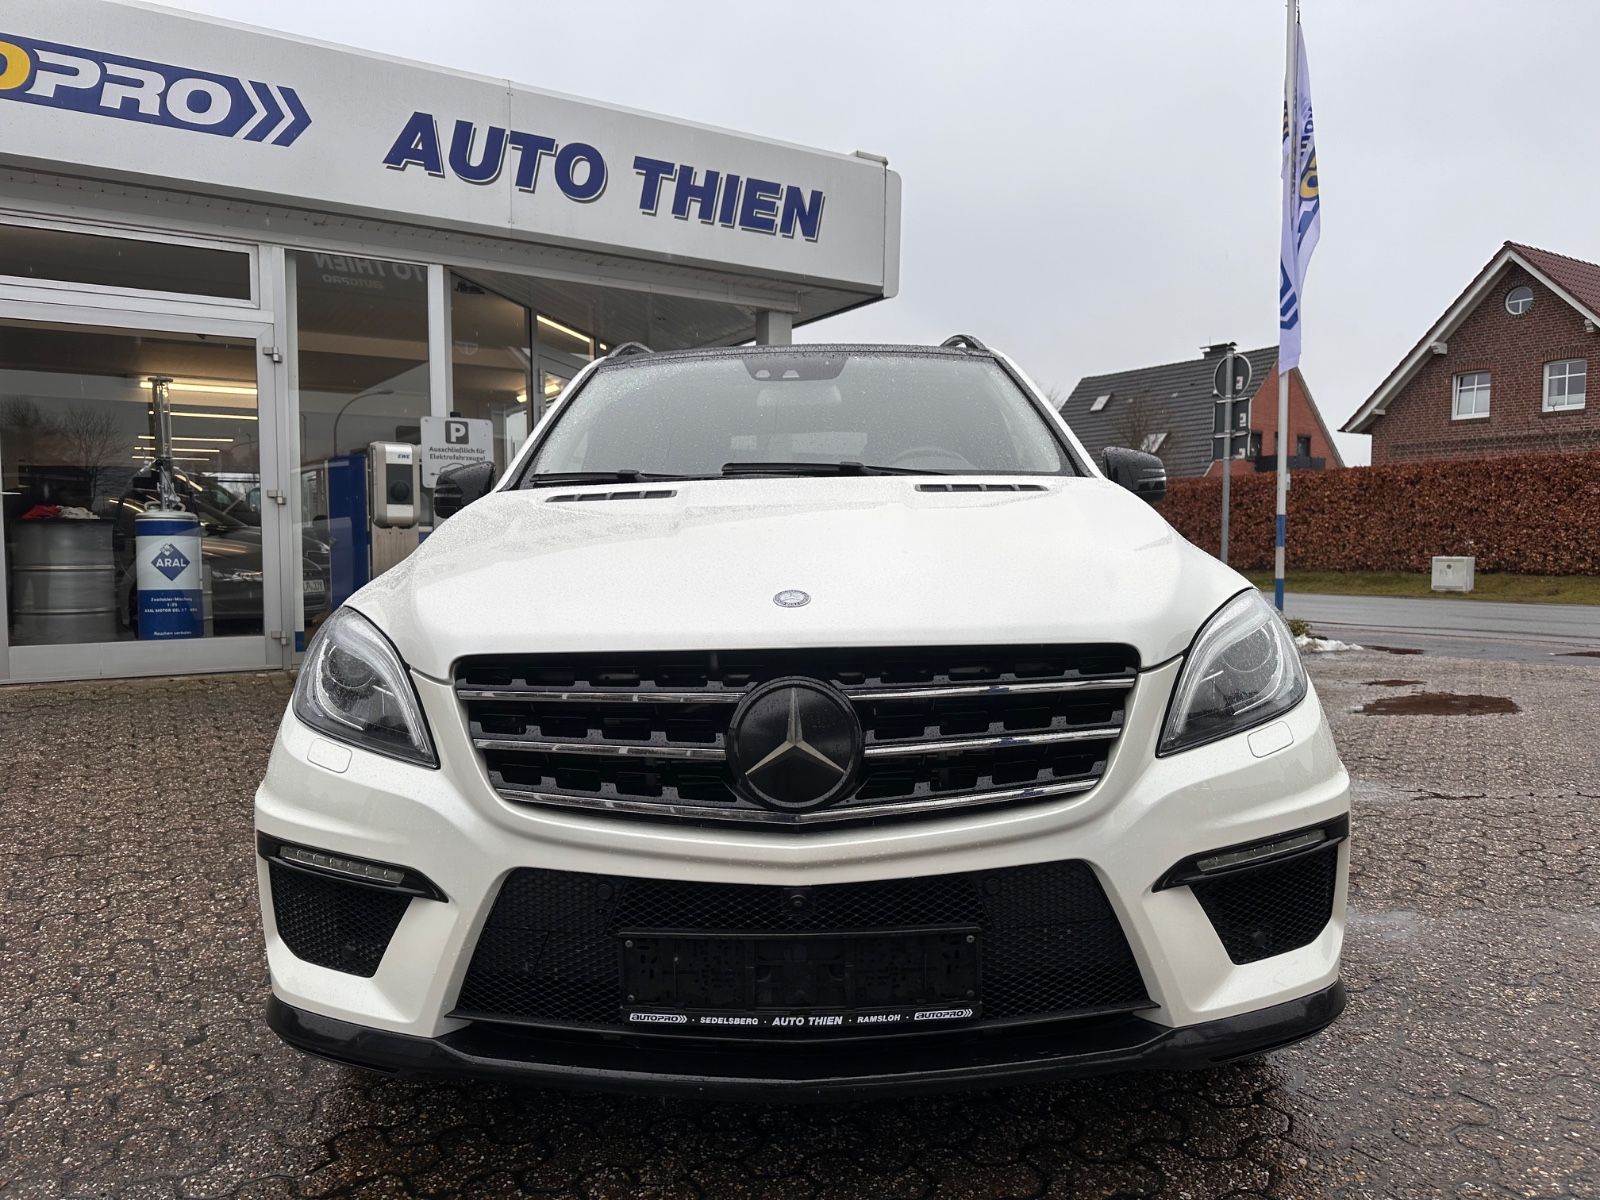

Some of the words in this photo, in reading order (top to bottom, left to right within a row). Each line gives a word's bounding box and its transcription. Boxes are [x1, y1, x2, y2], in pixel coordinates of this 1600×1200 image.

[383, 111, 608, 203] AUTO
[633, 155, 825, 241] THIEN
[450, 422, 466, 442] P
[156, 558, 187, 567] ARAL
[700, 1016, 759, 1025] SEDELSBERG
[772, 1016, 805, 1026] AUTO
[808, 1016, 844, 1026] THIEN
[857, 1014, 901, 1023] RAMSLOH
